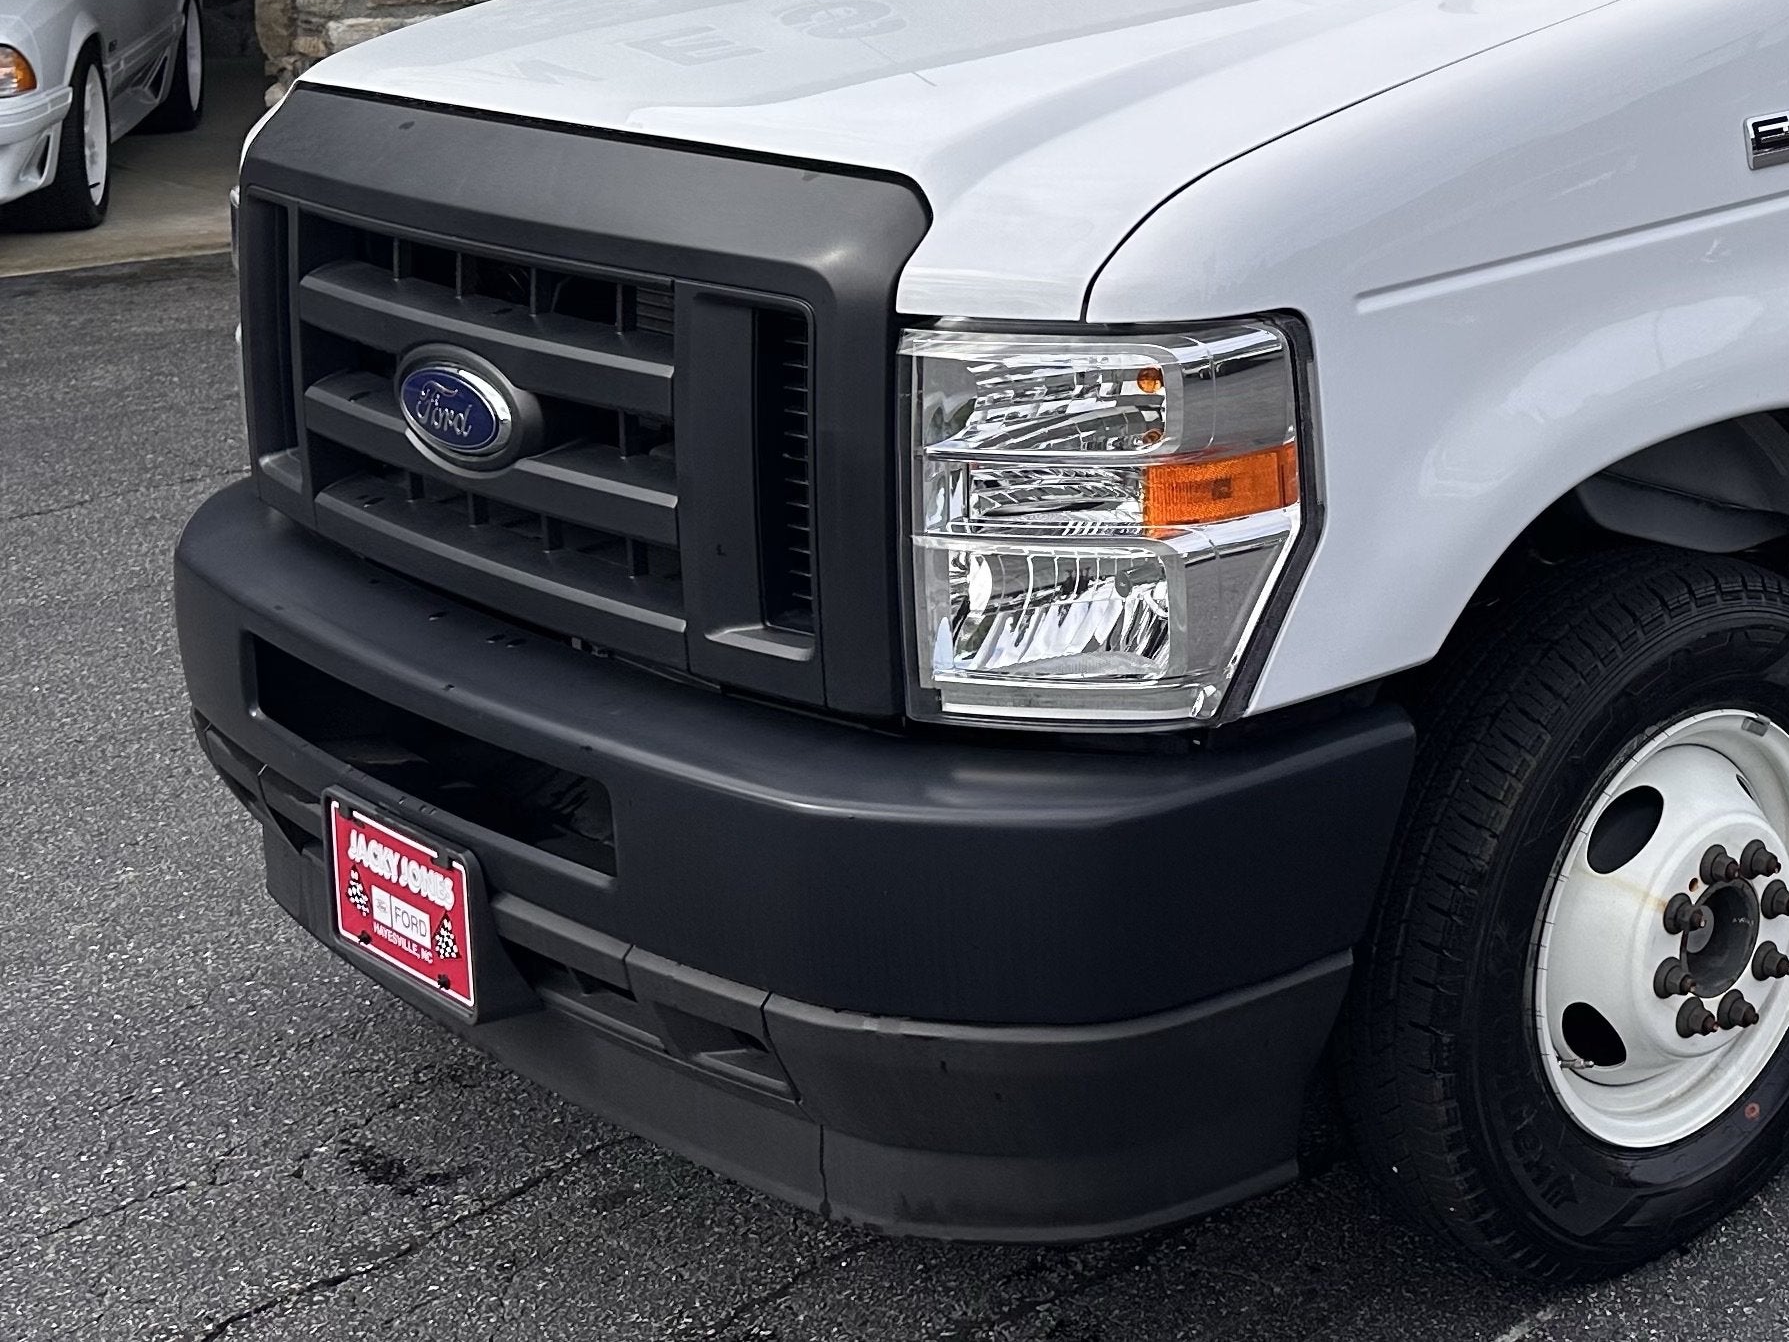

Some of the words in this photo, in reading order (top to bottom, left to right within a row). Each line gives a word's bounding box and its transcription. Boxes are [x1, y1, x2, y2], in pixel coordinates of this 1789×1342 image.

[415, 380, 472, 438] Ford
[347, 828, 400, 884] JACKY
[398, 855, 455, 912] JONES
[394, 905, 428, 938] FORD
